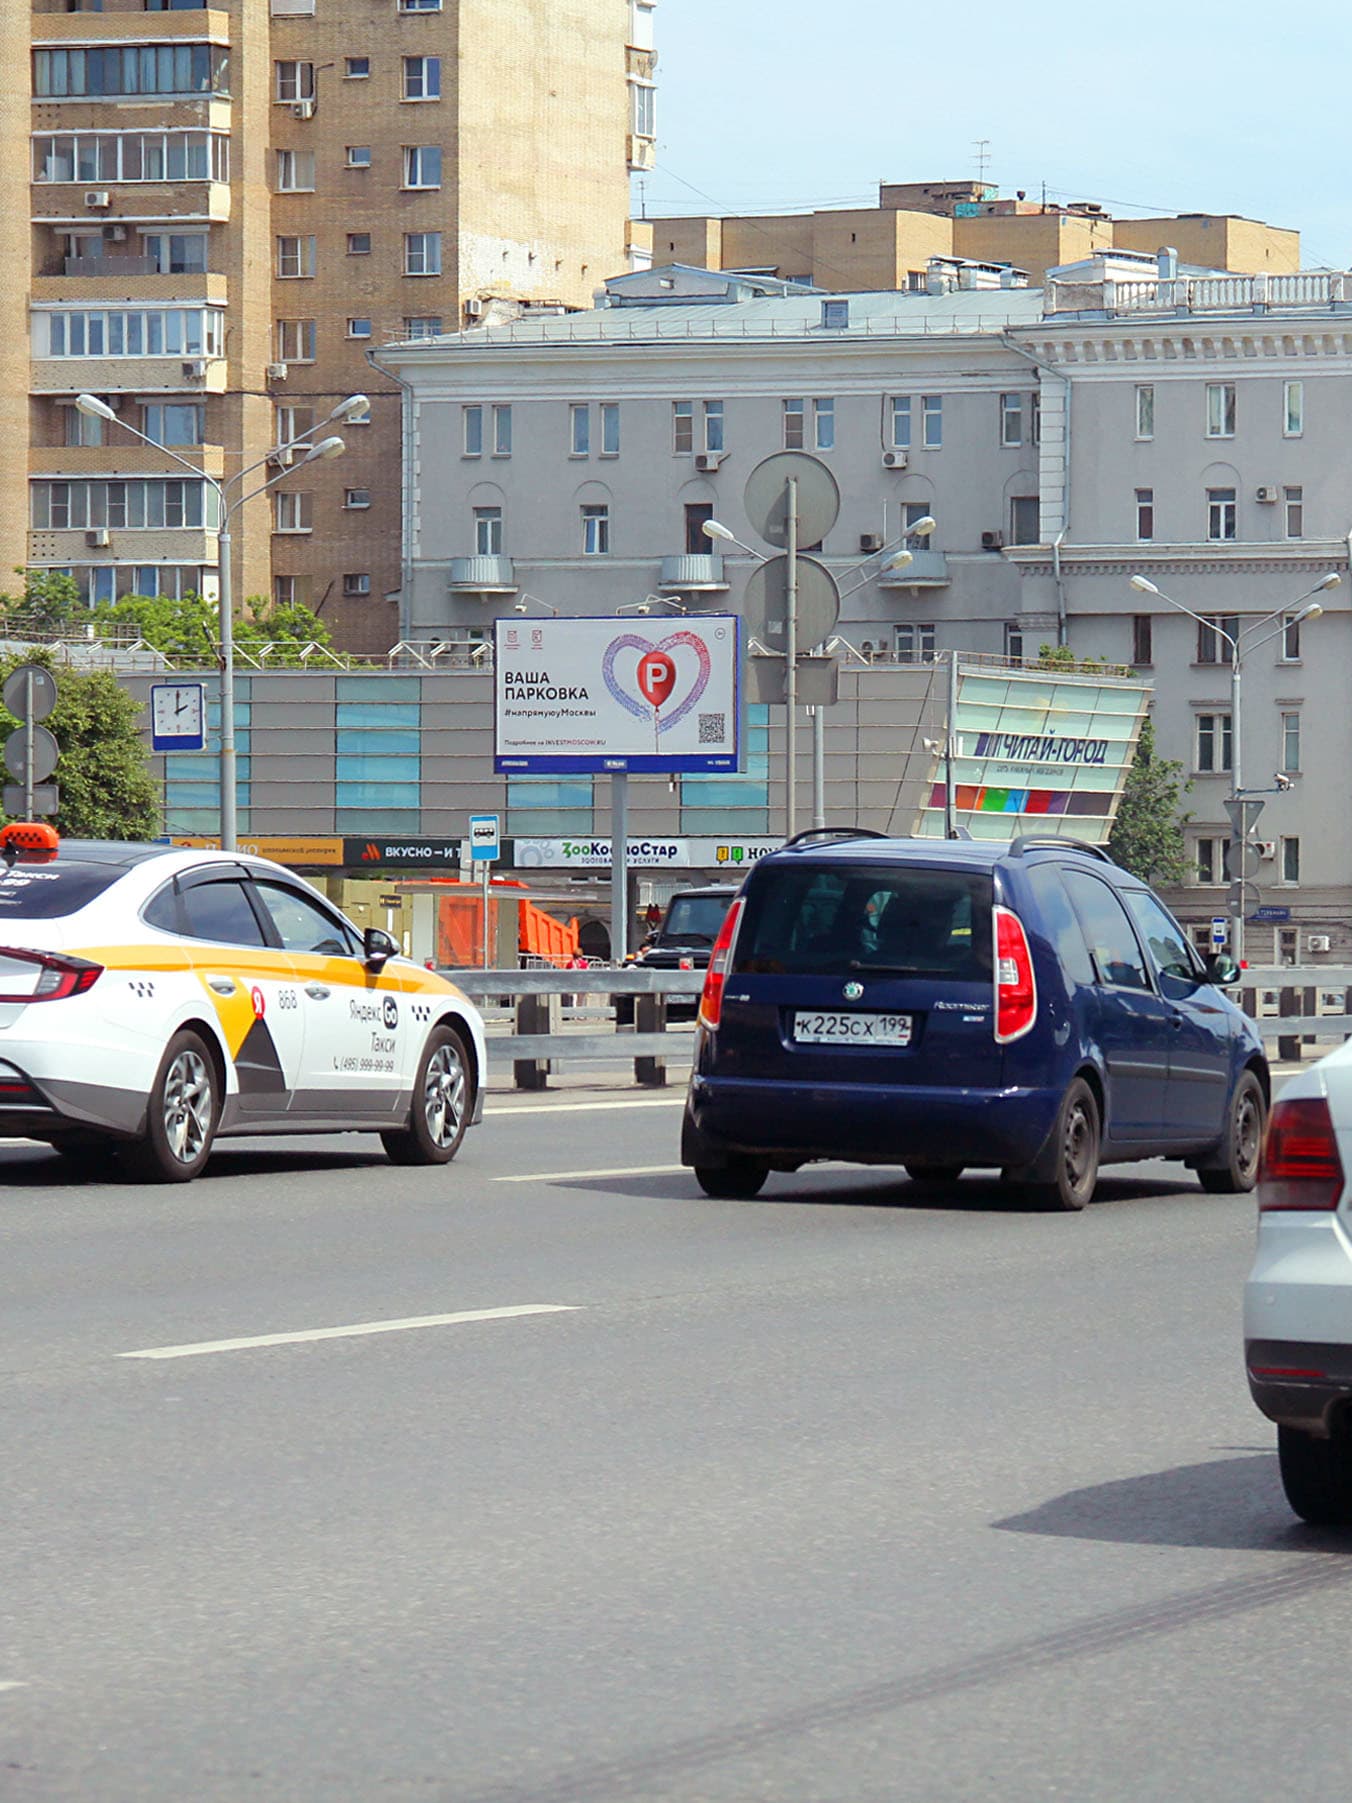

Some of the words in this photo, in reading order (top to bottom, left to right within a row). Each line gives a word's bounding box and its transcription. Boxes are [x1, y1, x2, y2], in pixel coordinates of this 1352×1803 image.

[504, 671, 550, 684] ВАША
[504, 687, 589, 700] ПАРКОВКА
[385, 846, 432, 858] ВКУСНО
[278, 990, 298, 1010] 868
[349, 999, 382, 1024] Яндекс
[371, 1031, 396, 1054] Такси
